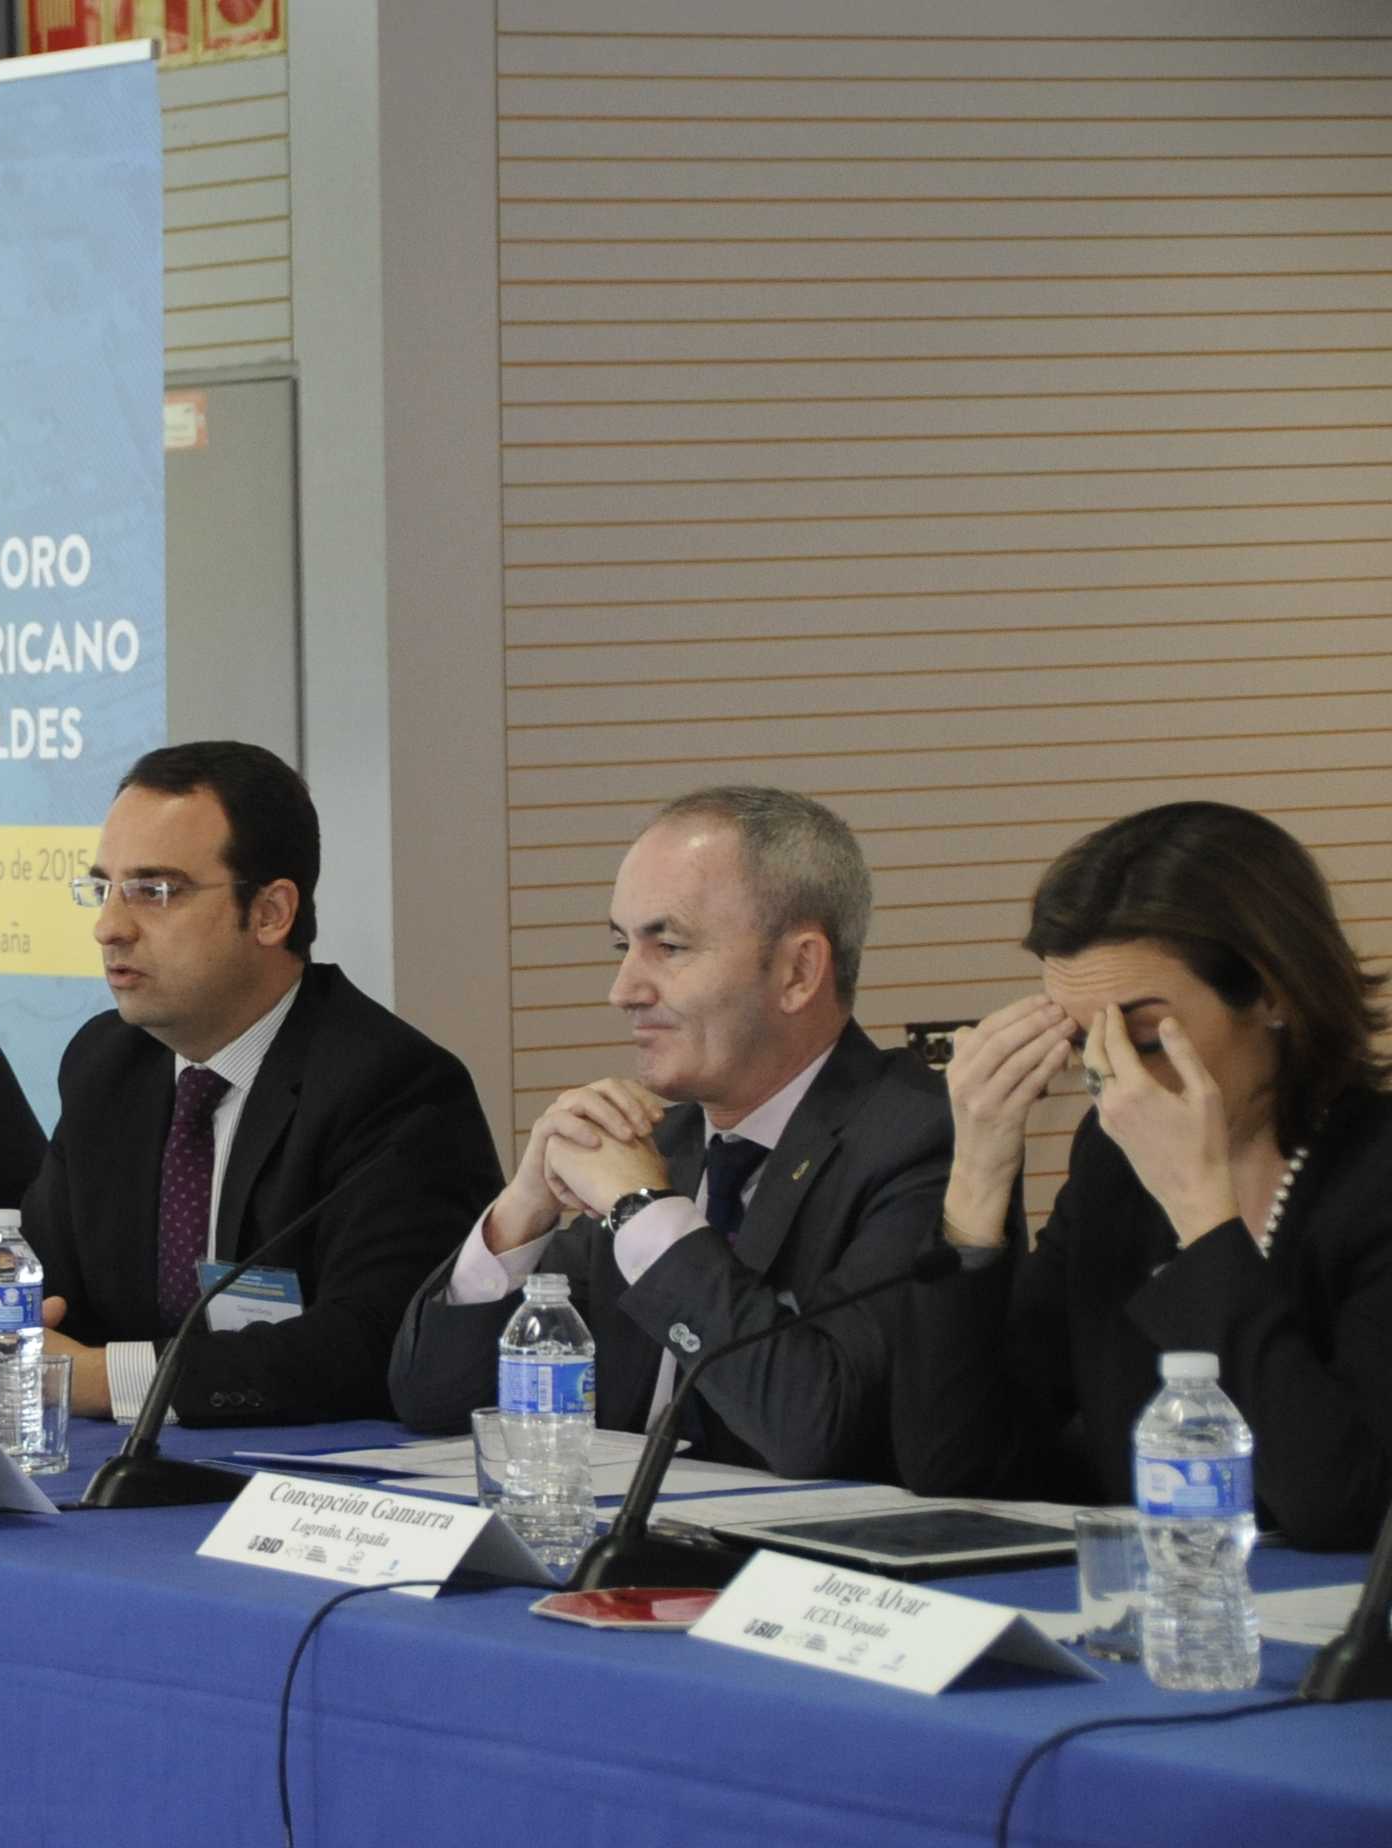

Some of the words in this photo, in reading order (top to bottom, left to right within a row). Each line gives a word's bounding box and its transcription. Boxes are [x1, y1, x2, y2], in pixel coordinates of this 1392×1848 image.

[10, 849, 33, 881] de
[38, 848, 90, 881] 2015
[269, 1479, 369, 1516] Concepción
[370, 1496, 456, 1531] Gamarra
[257, 1536, 285, 1555] BID
[346, 1526, 390, 1548] España
[813, 1572, 872, 1607] Jorge
[869, 1586, 931, 1617] Alvar
[803, 1604, 840, 1628] ICEX
